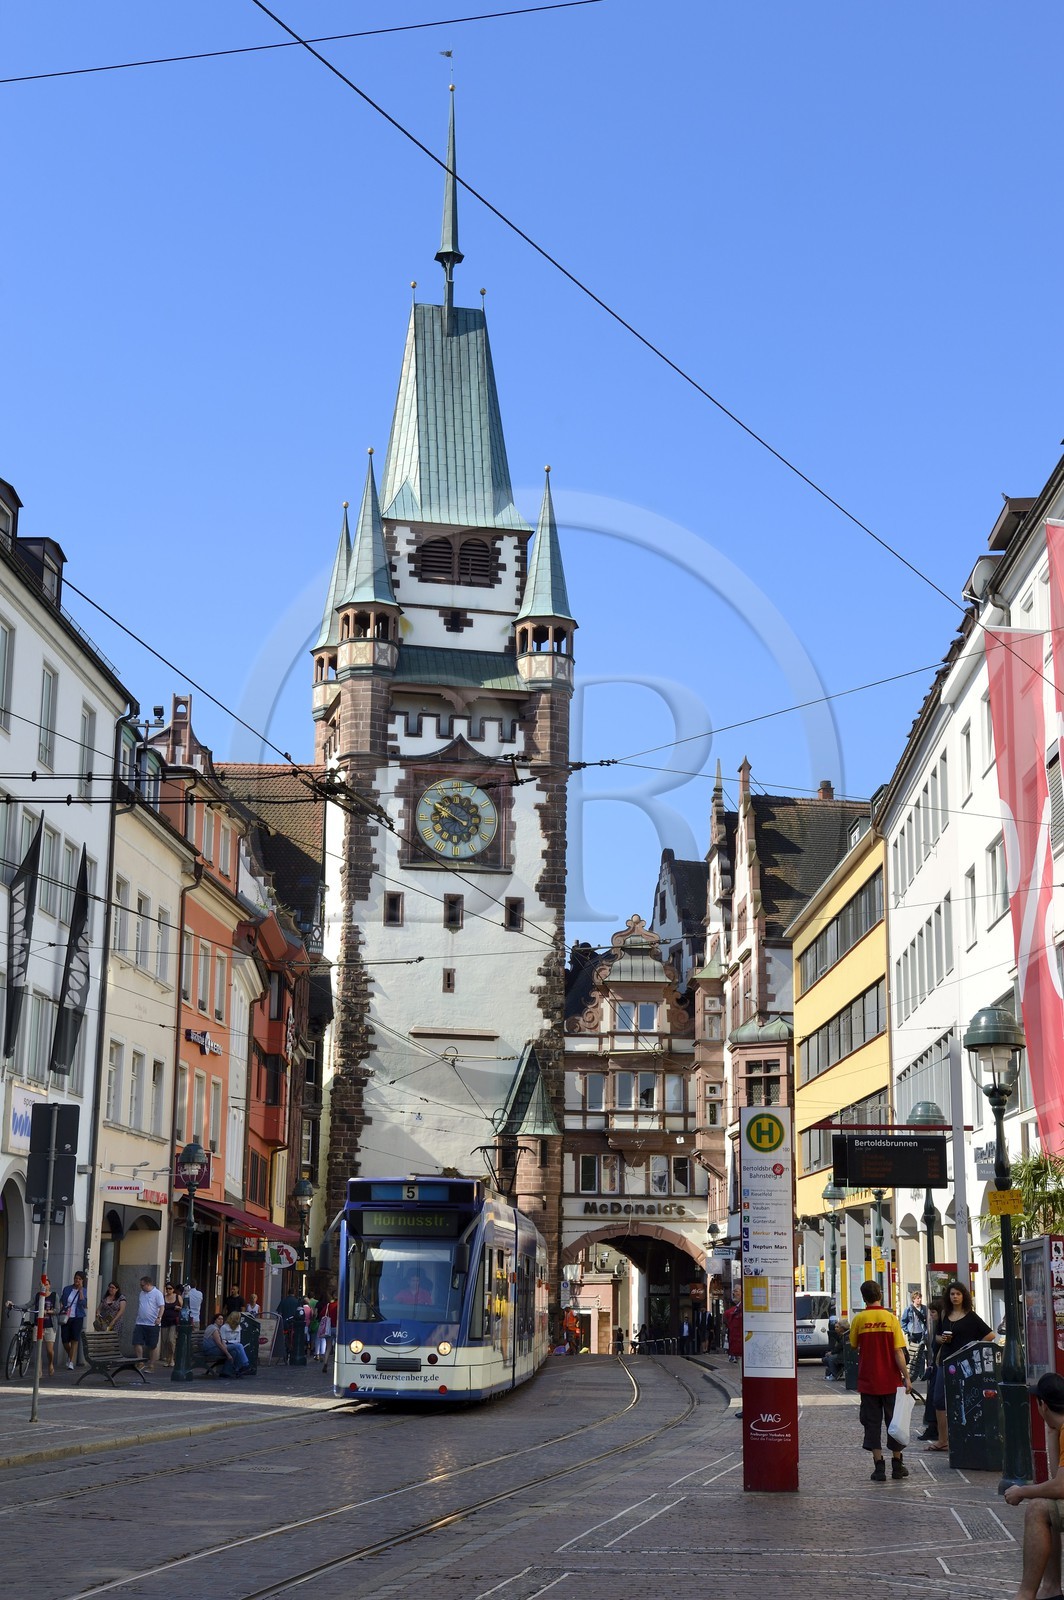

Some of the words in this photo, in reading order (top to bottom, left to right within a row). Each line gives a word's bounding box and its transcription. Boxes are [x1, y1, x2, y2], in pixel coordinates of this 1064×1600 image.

[756, 1122, 774, 1143] H
[854, 1139, 918, 1148] Bertoldsbrunnen
[406, 1186, 416, 1199] 5
[583, 1201, 686, 1216] McDonald's
[373, 1213, 450, 1227] Hornusstr.
[392, 1331, 408, 1339] VAG
[359, 1373, 440, 1383] www.fuerstenberg.de
[760, 1413, 781, 1423] VAG
